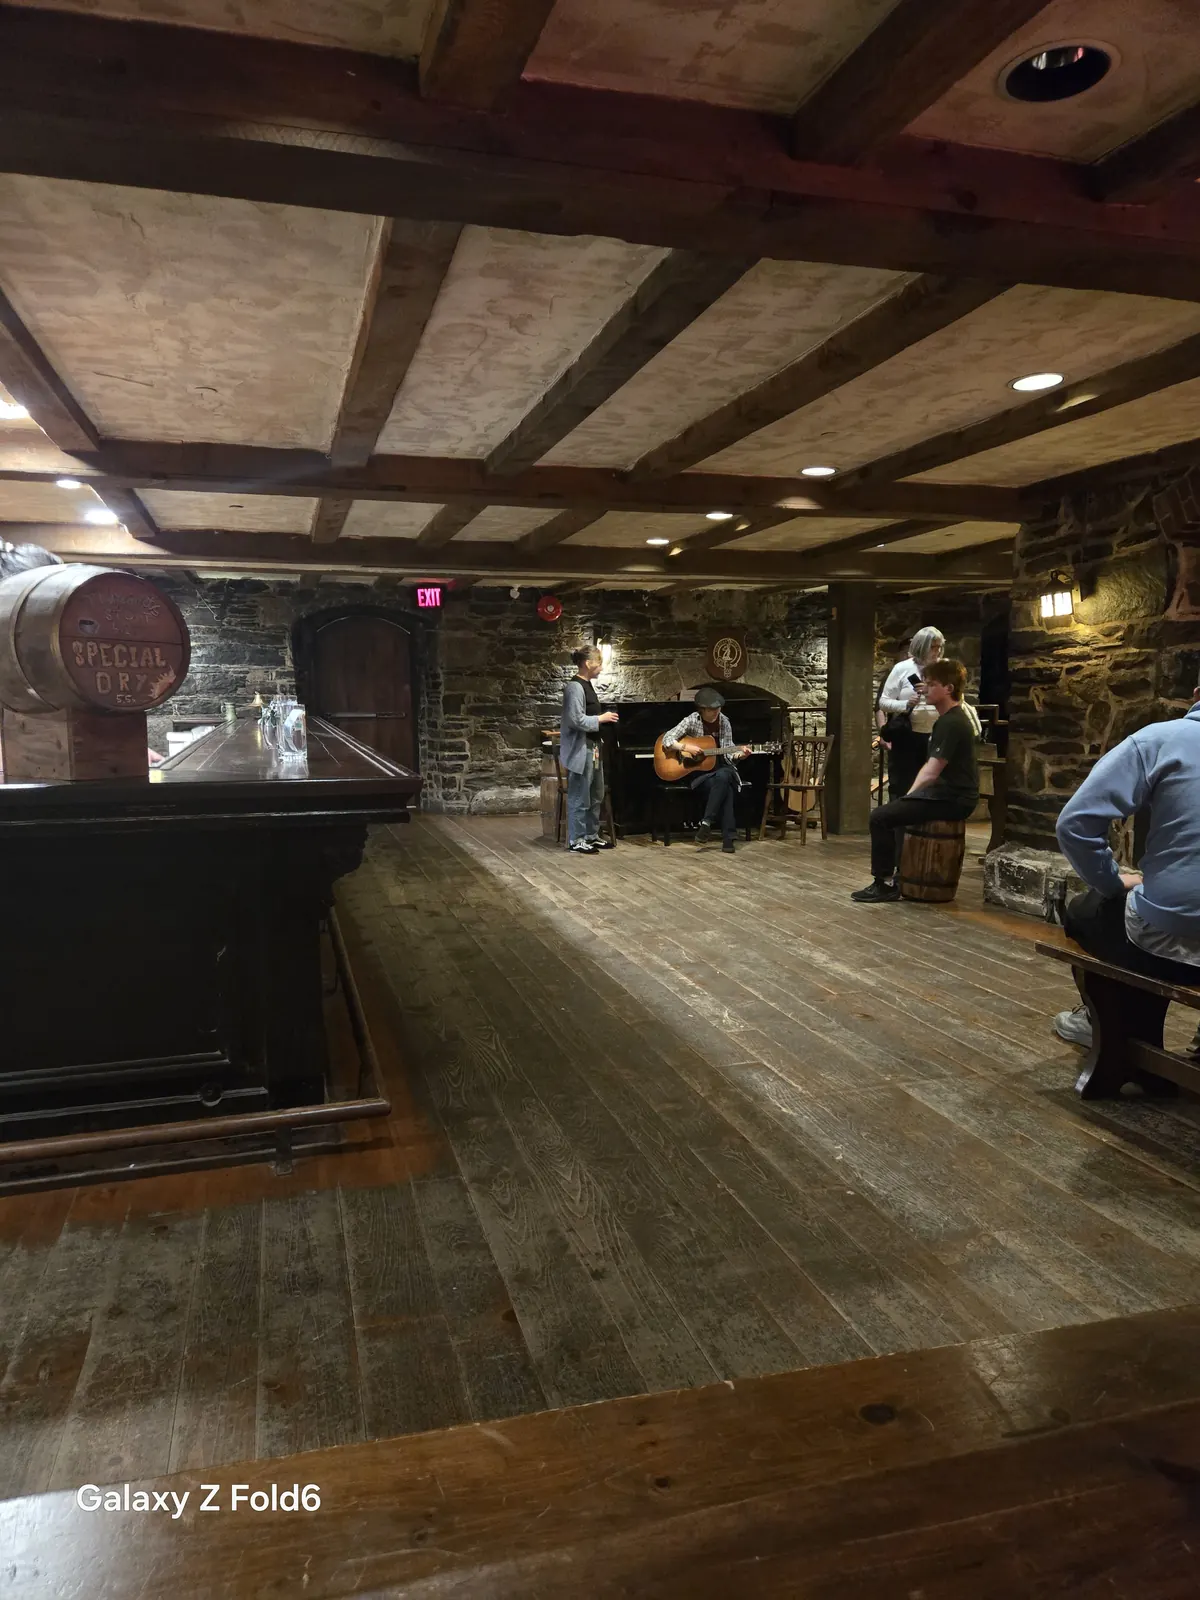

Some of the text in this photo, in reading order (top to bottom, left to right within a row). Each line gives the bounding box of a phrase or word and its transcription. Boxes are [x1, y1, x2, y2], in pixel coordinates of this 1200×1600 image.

[417, 588, 441, 607] EXIT
[72, 640, 167, 668] SPECIAL
[96, 671, 148, 694] DRY
